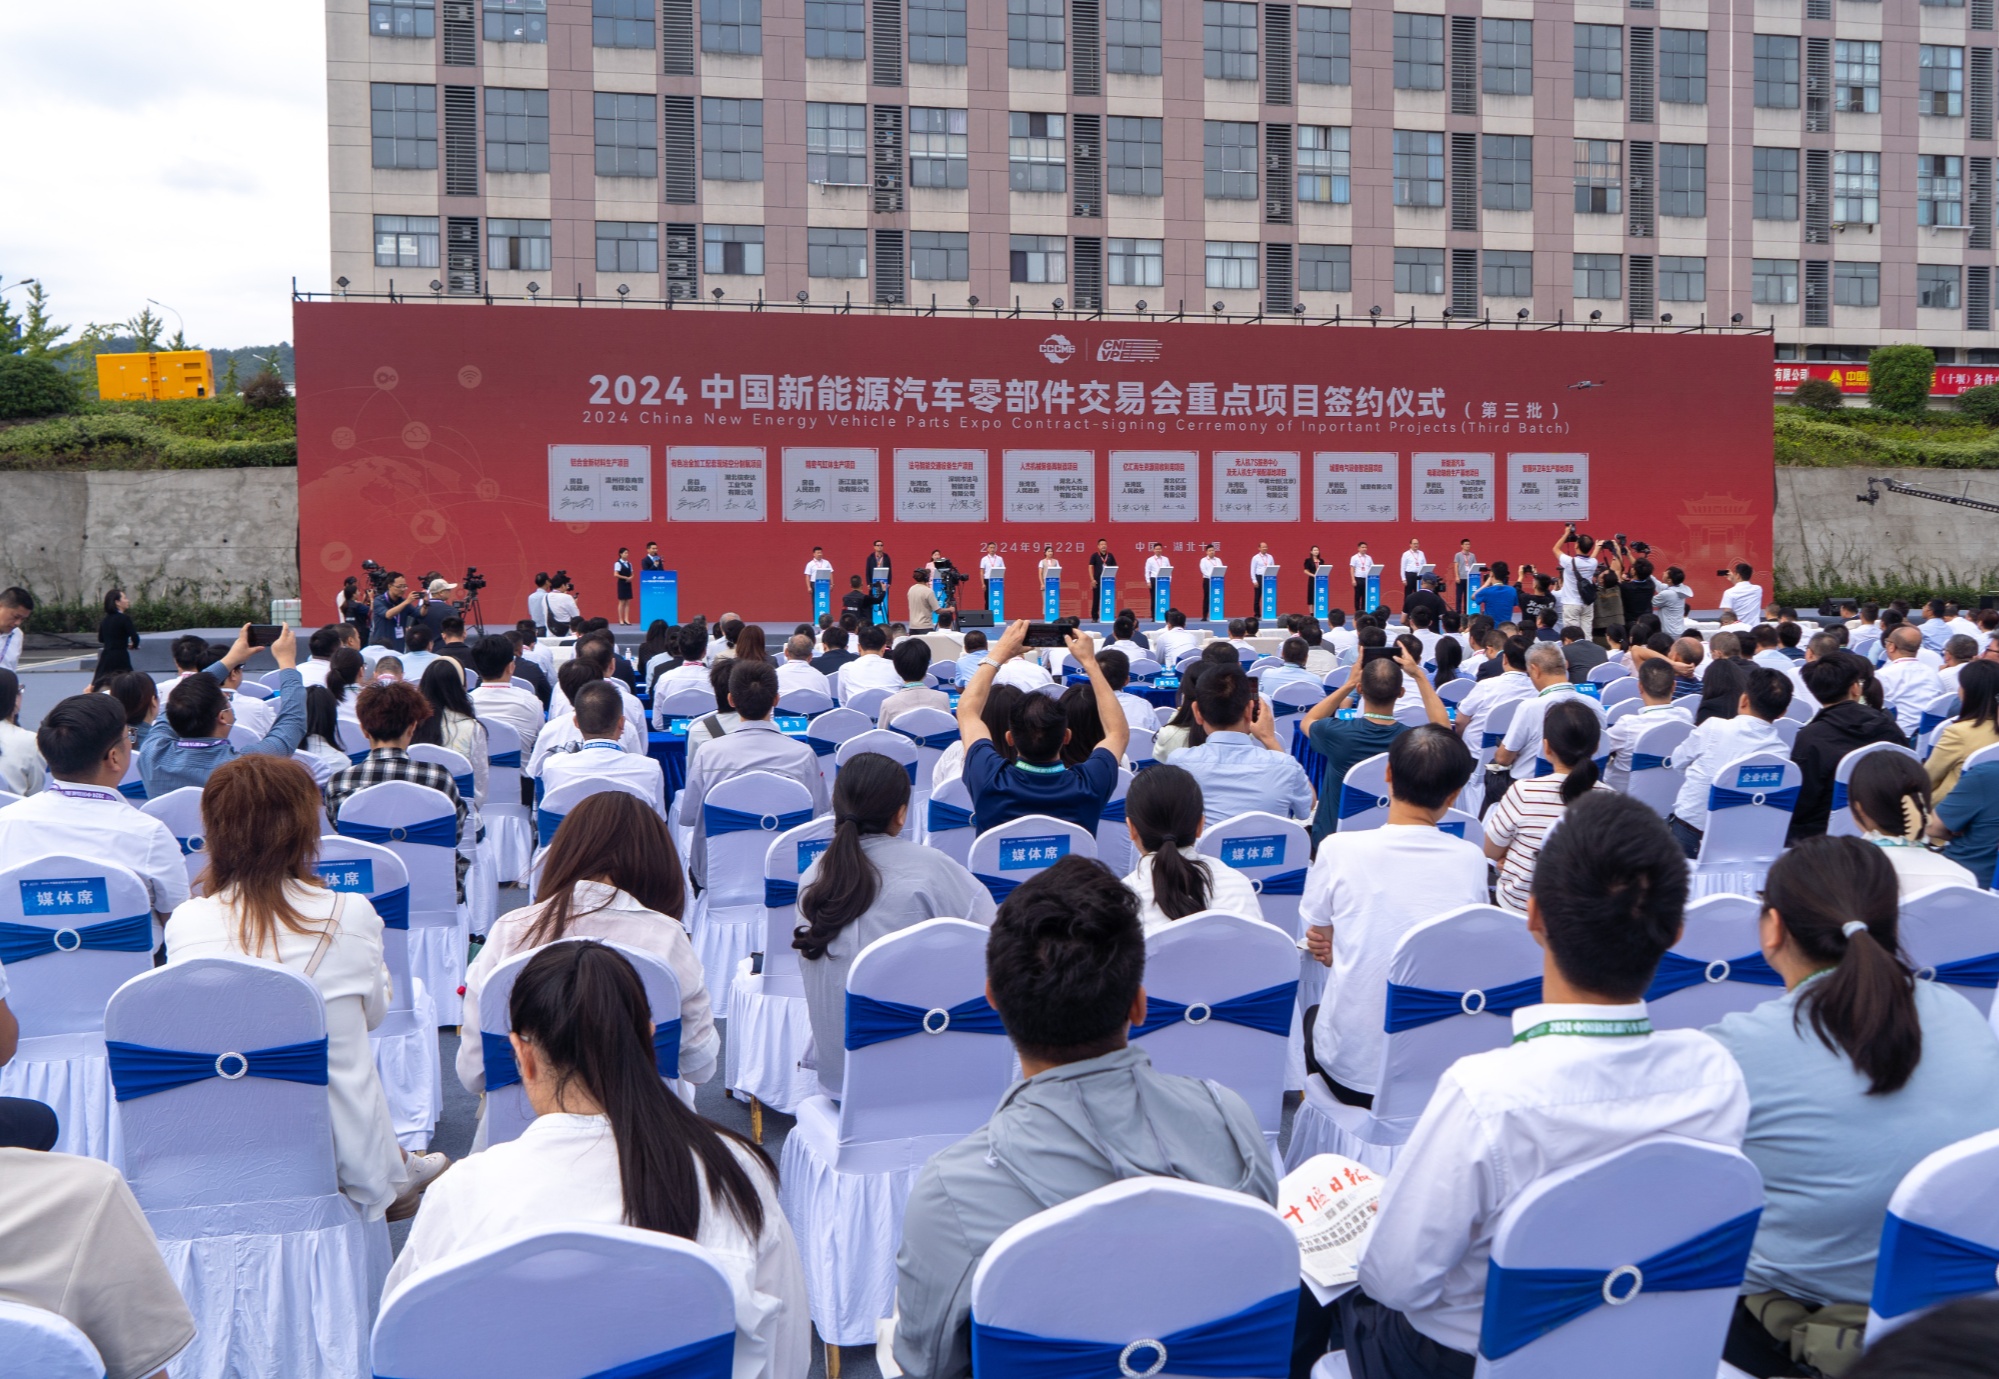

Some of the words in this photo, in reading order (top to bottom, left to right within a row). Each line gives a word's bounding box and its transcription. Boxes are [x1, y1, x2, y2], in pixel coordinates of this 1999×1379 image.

[1774, 368, 1808, 382] 有限公司
[1846, 371, 1870, 382] 中国
[588, 374, 688, 405] 2024
[701, 373, 1446, 419] 中国新能源汽车零部件交易会重点项目签约仪式
[583, 411, 629, 423] 2024
[640, 412, 693, 424] China
[704, 413, 742, 425] New
[753, 413, 818, 429] Energy
[828, 415, 896, 428] Vehicle
[907, 416, 950, 429] Parts
[960, 416, 1002, 431] Expo
[1012, 417, 1166, 433] Contract-signing
[1176, 418, 1268, 434] Cerremony
[1277, 420, 1292, 432] of
[1302, 420, 1381, 434] Inportant
[1518, 422, 1570, 434] Batch)
[1742, 772, 1780, 783] 企业代表
[1012, 846, 1058, 861] 媒体席
[1231, 846, 1275, 861] 媒体席
[36, 889, 94, 907] 媒体席
[1283, 1167, 1373, 1224] 十堰日报
